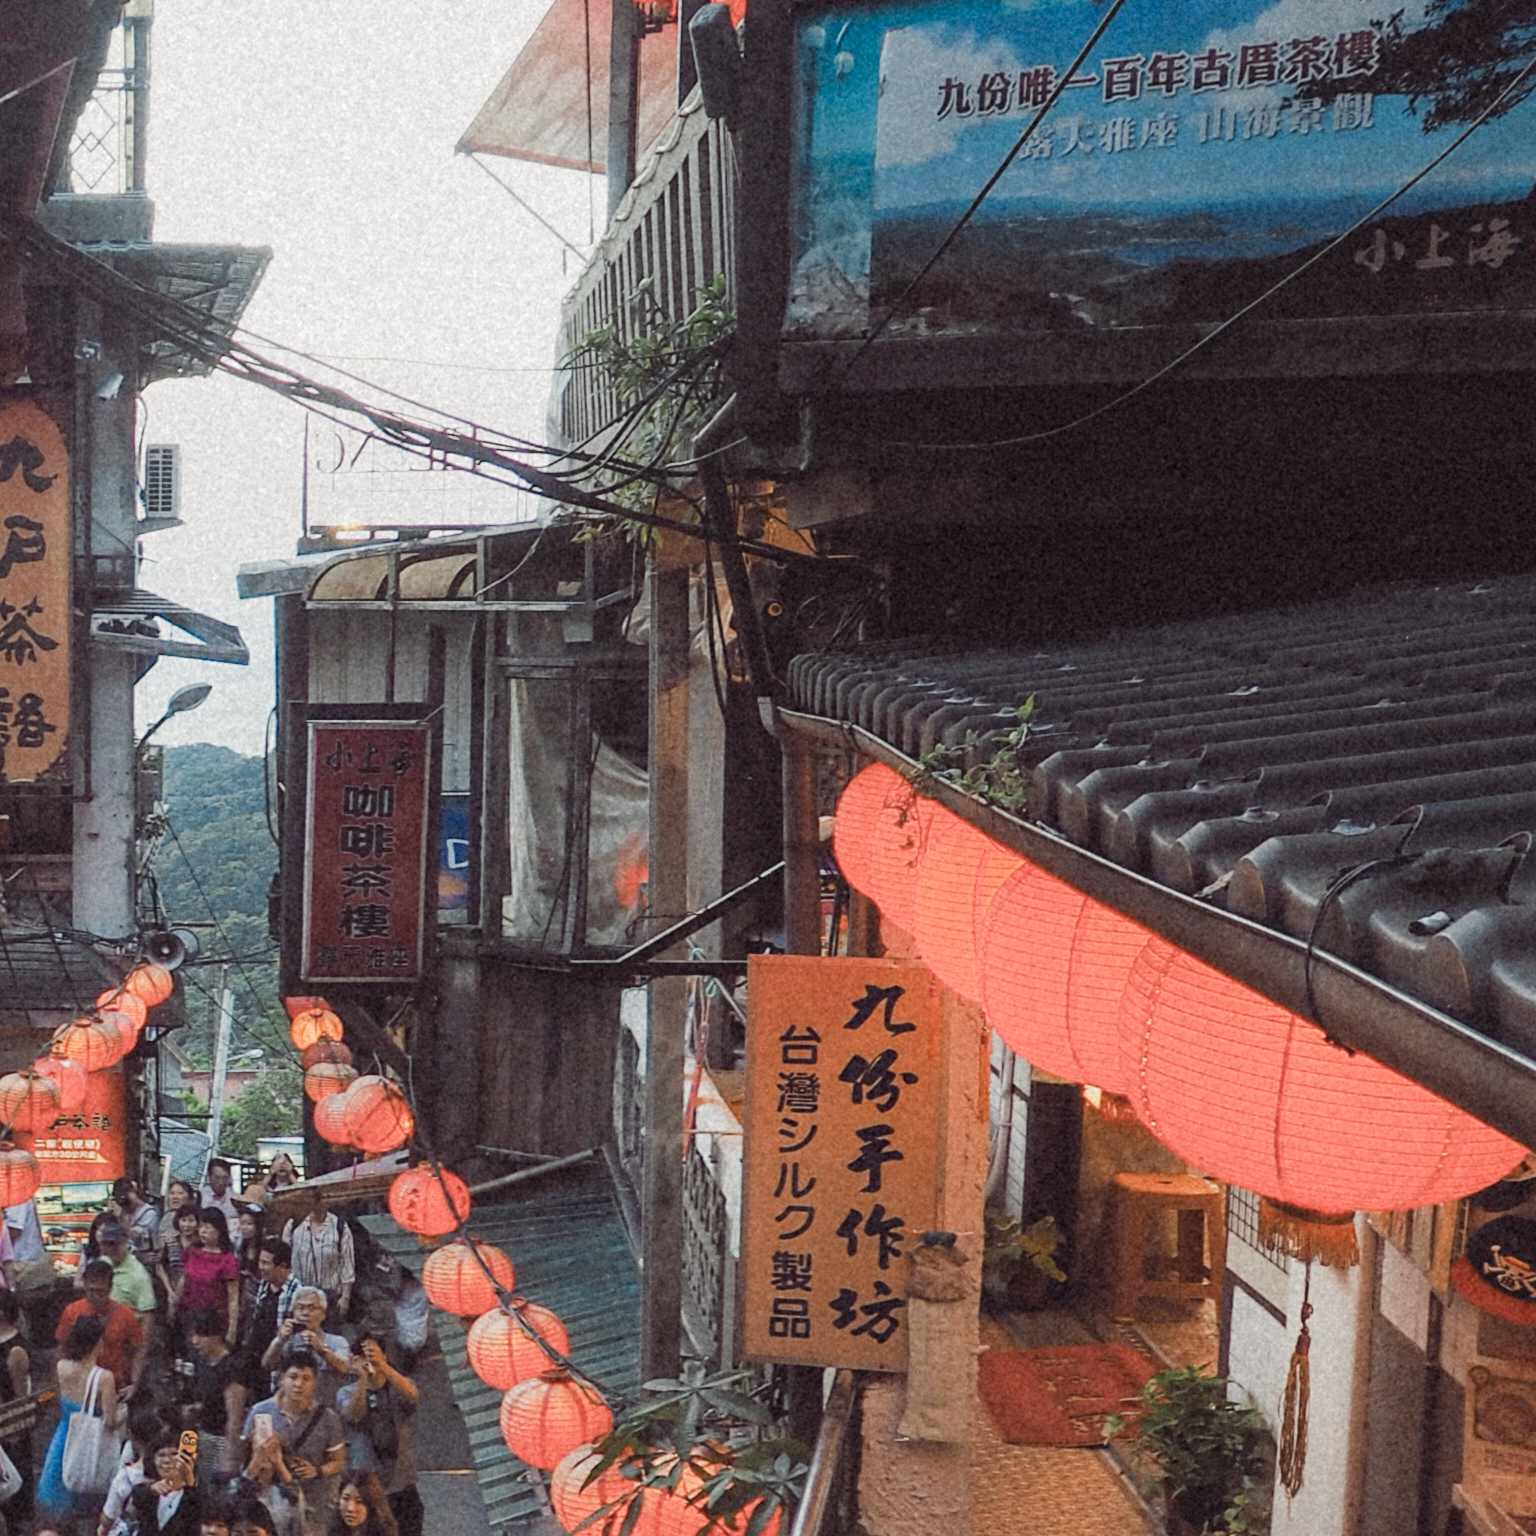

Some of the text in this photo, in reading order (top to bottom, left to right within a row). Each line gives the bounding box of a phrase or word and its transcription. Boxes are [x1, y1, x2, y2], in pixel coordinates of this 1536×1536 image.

[936, 30, 1381, 119] 九份唯一百年古厝茶樓
[1018, 92, 1375, 160] 露天雅座 山海景觀
[1354, 217, 1522, 272] 小上海
[338, 784, 396, 940] 咖啡茶樓
[768, 1024, 822, 1339] 台灣シルク製品
[828, 983, 919, 1344] 九份手作坊
